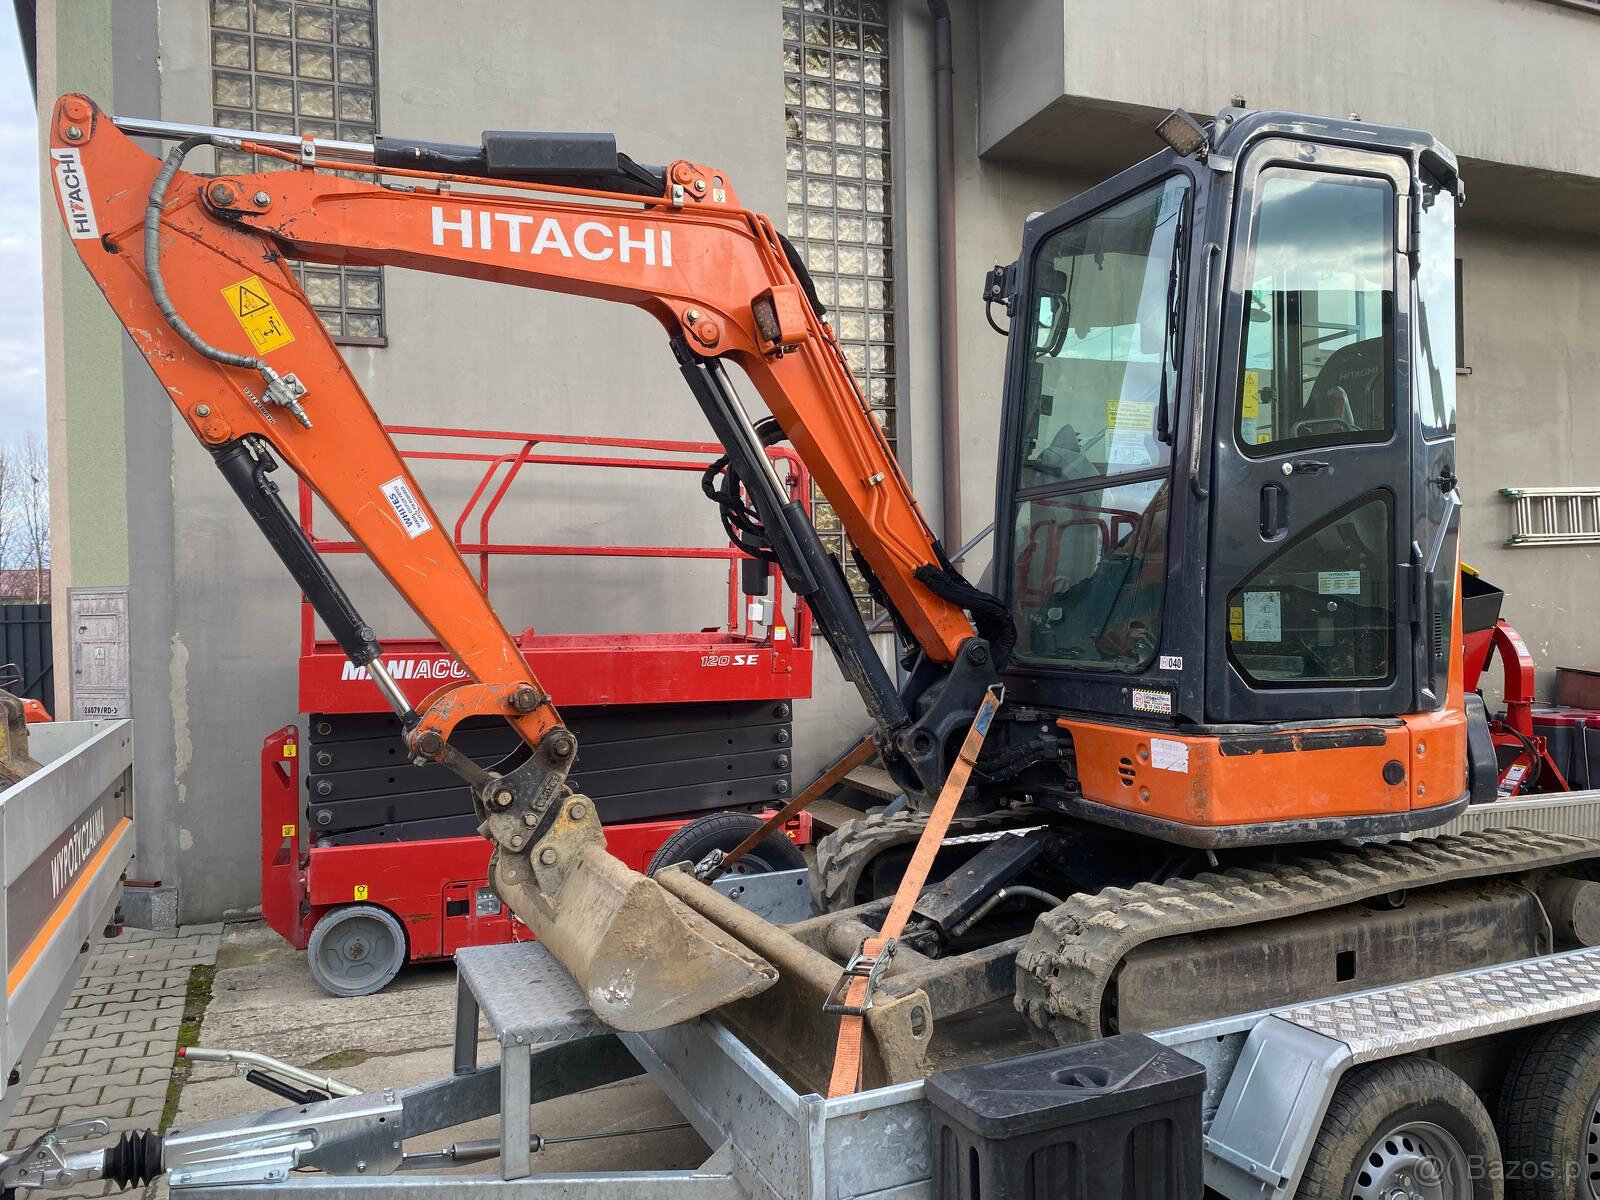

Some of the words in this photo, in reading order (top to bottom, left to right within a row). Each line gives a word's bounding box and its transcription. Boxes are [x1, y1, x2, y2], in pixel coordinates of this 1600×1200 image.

[59, 154, 91, 233] HITACHI
[431, 206, 673, 267] HITACHI
[387, 492, 414, 527] WHITES
[341, 659, 471, 680] MNIACC
[701, 655, 731, 667] 120
[732, 654, 759, 666] SE
[1168, 658, 1182, 669] 040
[51, 806, 105, 899] WYPOŻYCZALNIA
